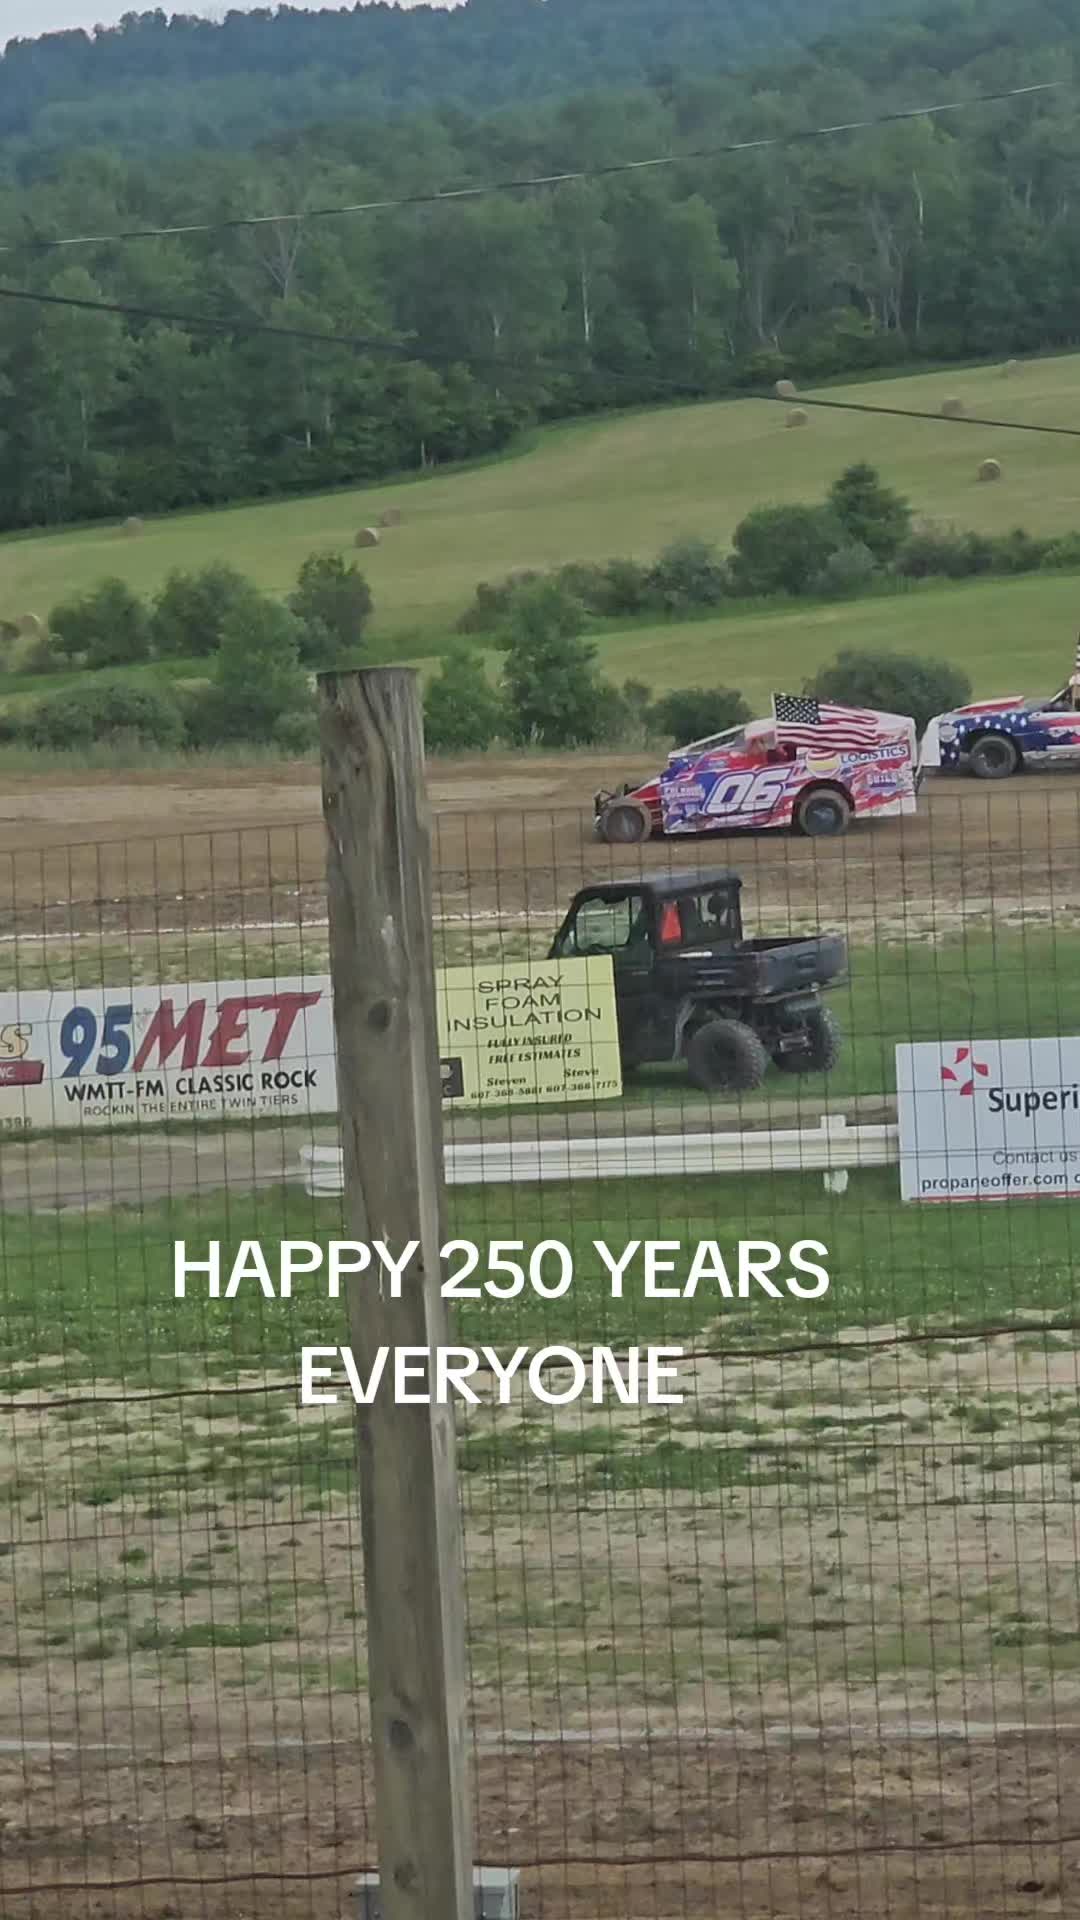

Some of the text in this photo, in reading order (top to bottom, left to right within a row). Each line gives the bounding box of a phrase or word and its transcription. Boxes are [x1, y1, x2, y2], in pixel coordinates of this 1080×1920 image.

[841, 746, 906, 764] LOGISTICS
[707, 769, 792, 813] 06
[478, 975, 563, 994] SPRAY
[486, 993, 560, 1011] FOAM
[447, 1008, 601, 1032] INSULATION
[518, 1048, 581, 1062] ESTIMATES
[64, 1069, 318, 1101] WMTT-FM CLASSIC ROCK
[486, 1068, 600, 1087] Steven Steve
[142, 1102, 165, 1113] THE
[170, 1099, 216, 1112] ENTIRE
[221, 1097, 256, 1109] TWIN
[260, 1094, 298, 1105] TIERS
[992, 1150, 1077, 1165] Contact us
[922, 1173, 1068, 1192] propaneoffer.com
